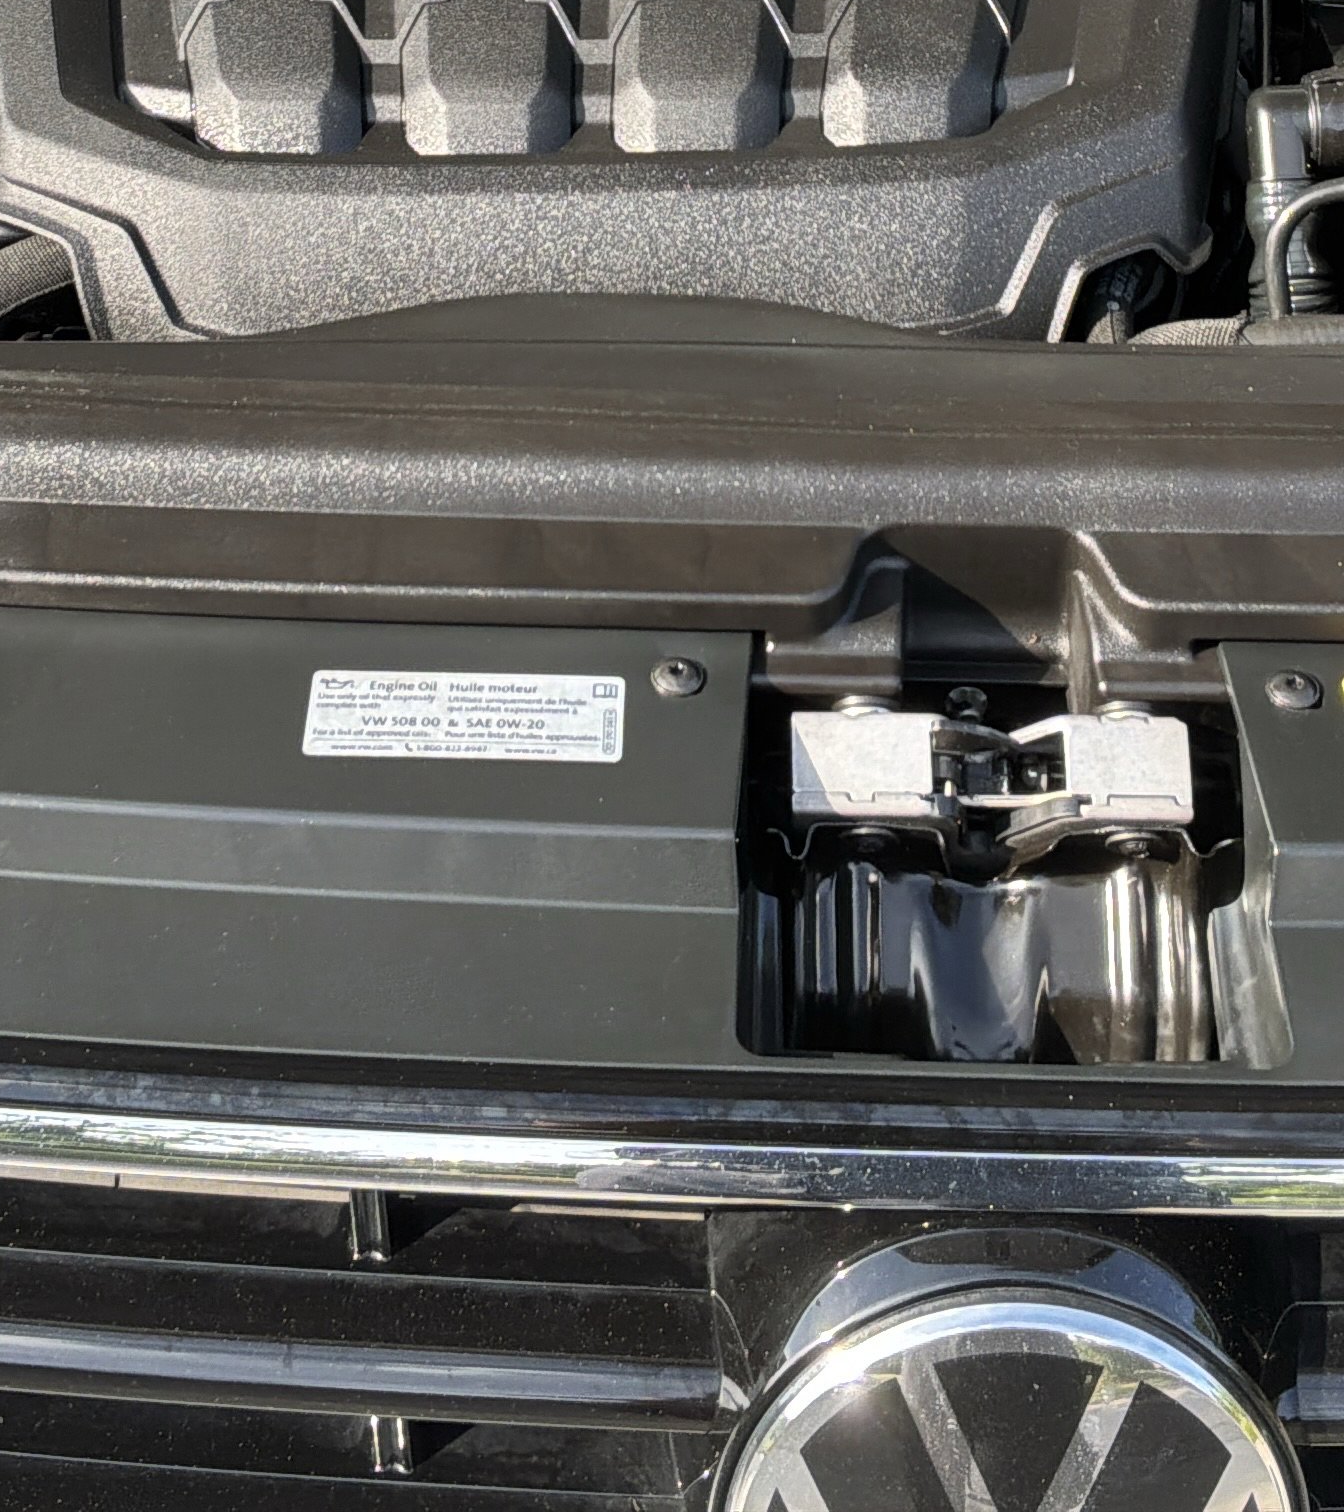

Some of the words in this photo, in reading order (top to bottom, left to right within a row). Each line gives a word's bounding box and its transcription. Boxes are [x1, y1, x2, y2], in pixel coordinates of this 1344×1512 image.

[369, 680, 415, 693] Engine
[418, 681, 438, 692] Oil
[449, 682, 485, 694] Huile
[488, 682, 538, 694] moteur
[361, 715, 388, 726] VW
[391, 715, 417, 727] 508
[421, 716, 441, 727] 00
[447, 718, 459, 727] &
[466, 718, 493, 729] SAE
[496, 718, 546, 730] 0W-20
